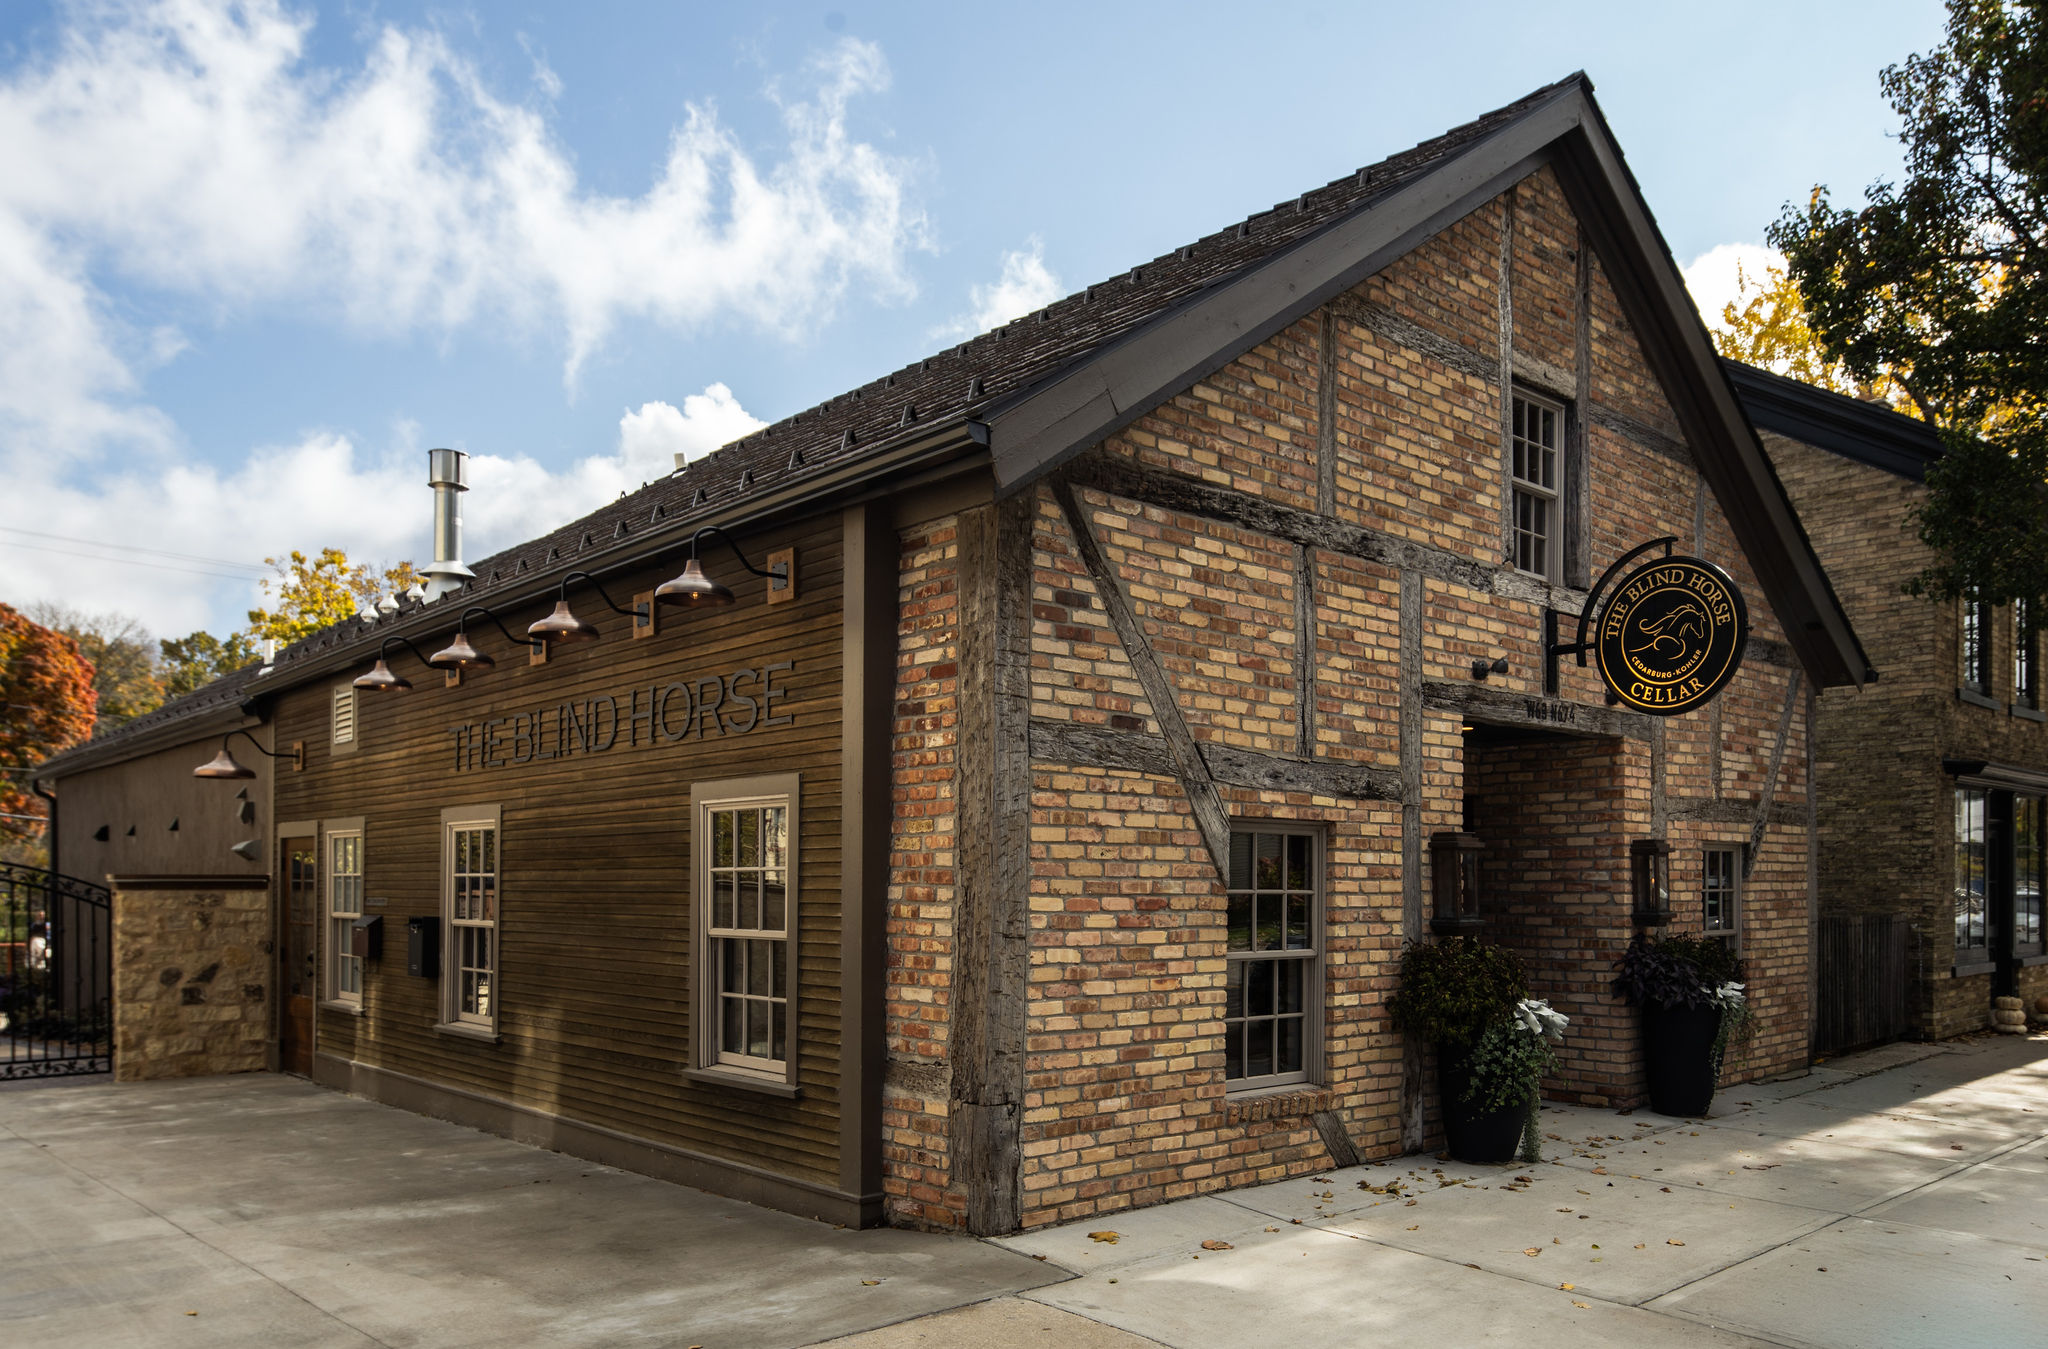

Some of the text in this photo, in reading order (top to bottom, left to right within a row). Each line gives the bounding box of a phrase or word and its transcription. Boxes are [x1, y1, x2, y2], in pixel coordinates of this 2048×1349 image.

[1605, 569, 1731, 640] THE BLIND HORSE
[448, 659, 794, 772] THE BLIND HORSE
[1630, 677, 1705, 703] CELLAR
